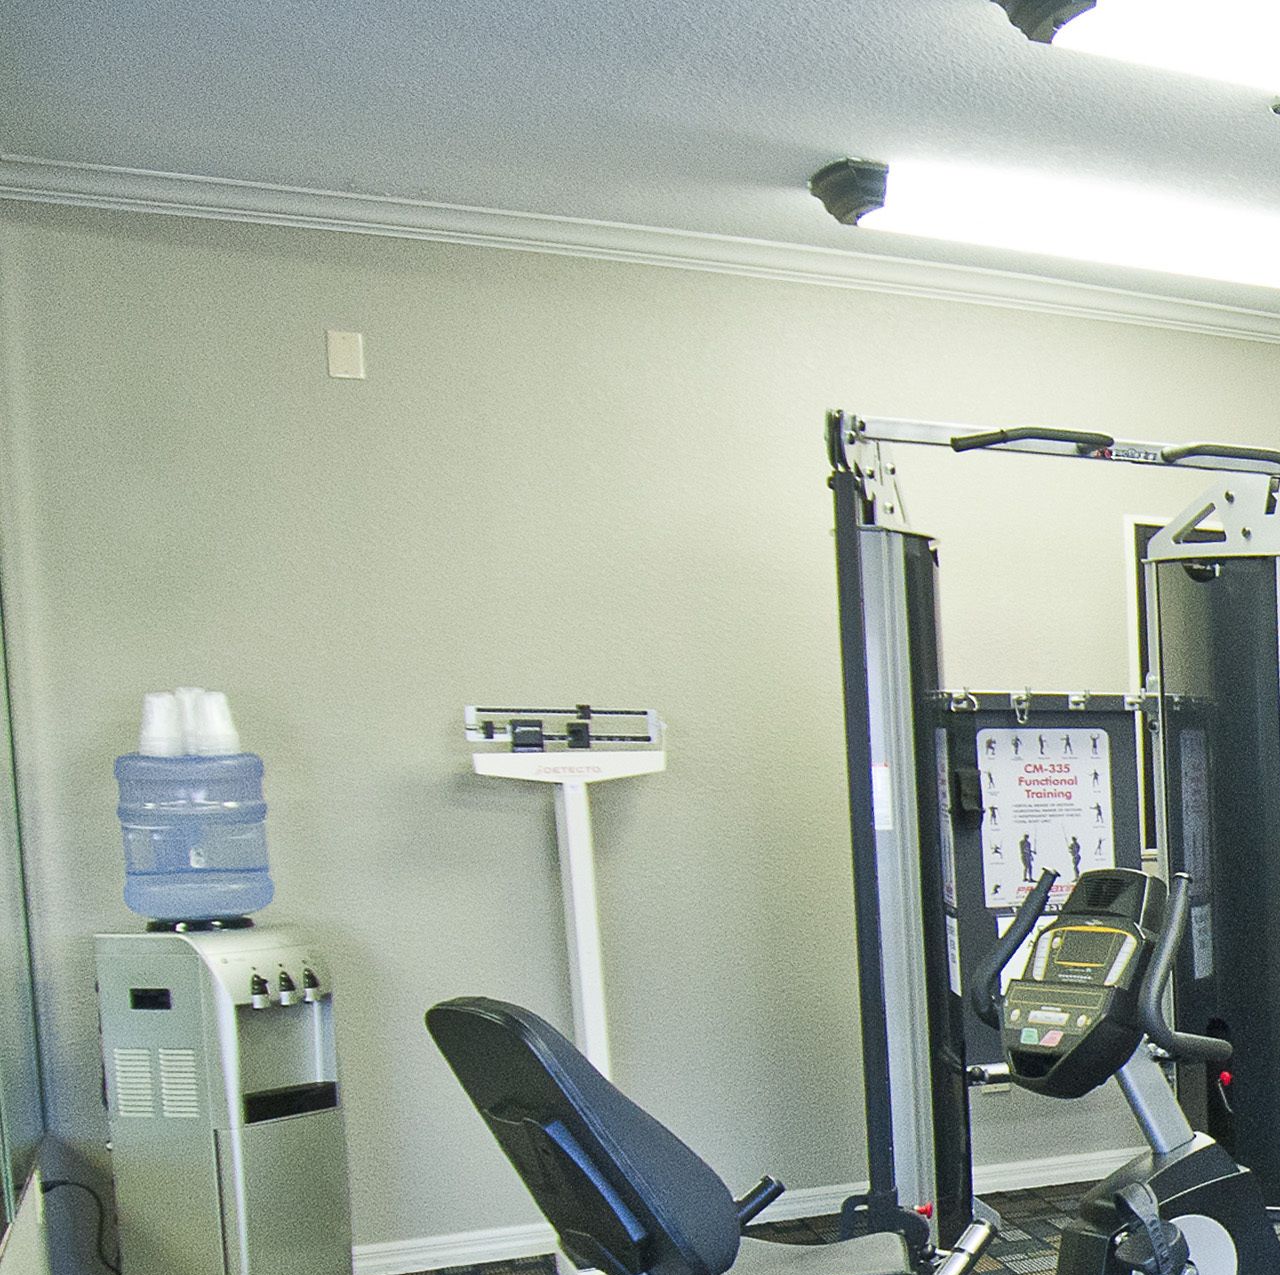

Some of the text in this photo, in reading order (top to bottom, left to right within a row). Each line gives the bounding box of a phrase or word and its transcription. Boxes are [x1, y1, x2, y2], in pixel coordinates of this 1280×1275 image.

[1023, 763, 1071, 774] CM-335
[1017, 775, 1079, 786] Functional
[1024, 788, 1073, 800] Training
